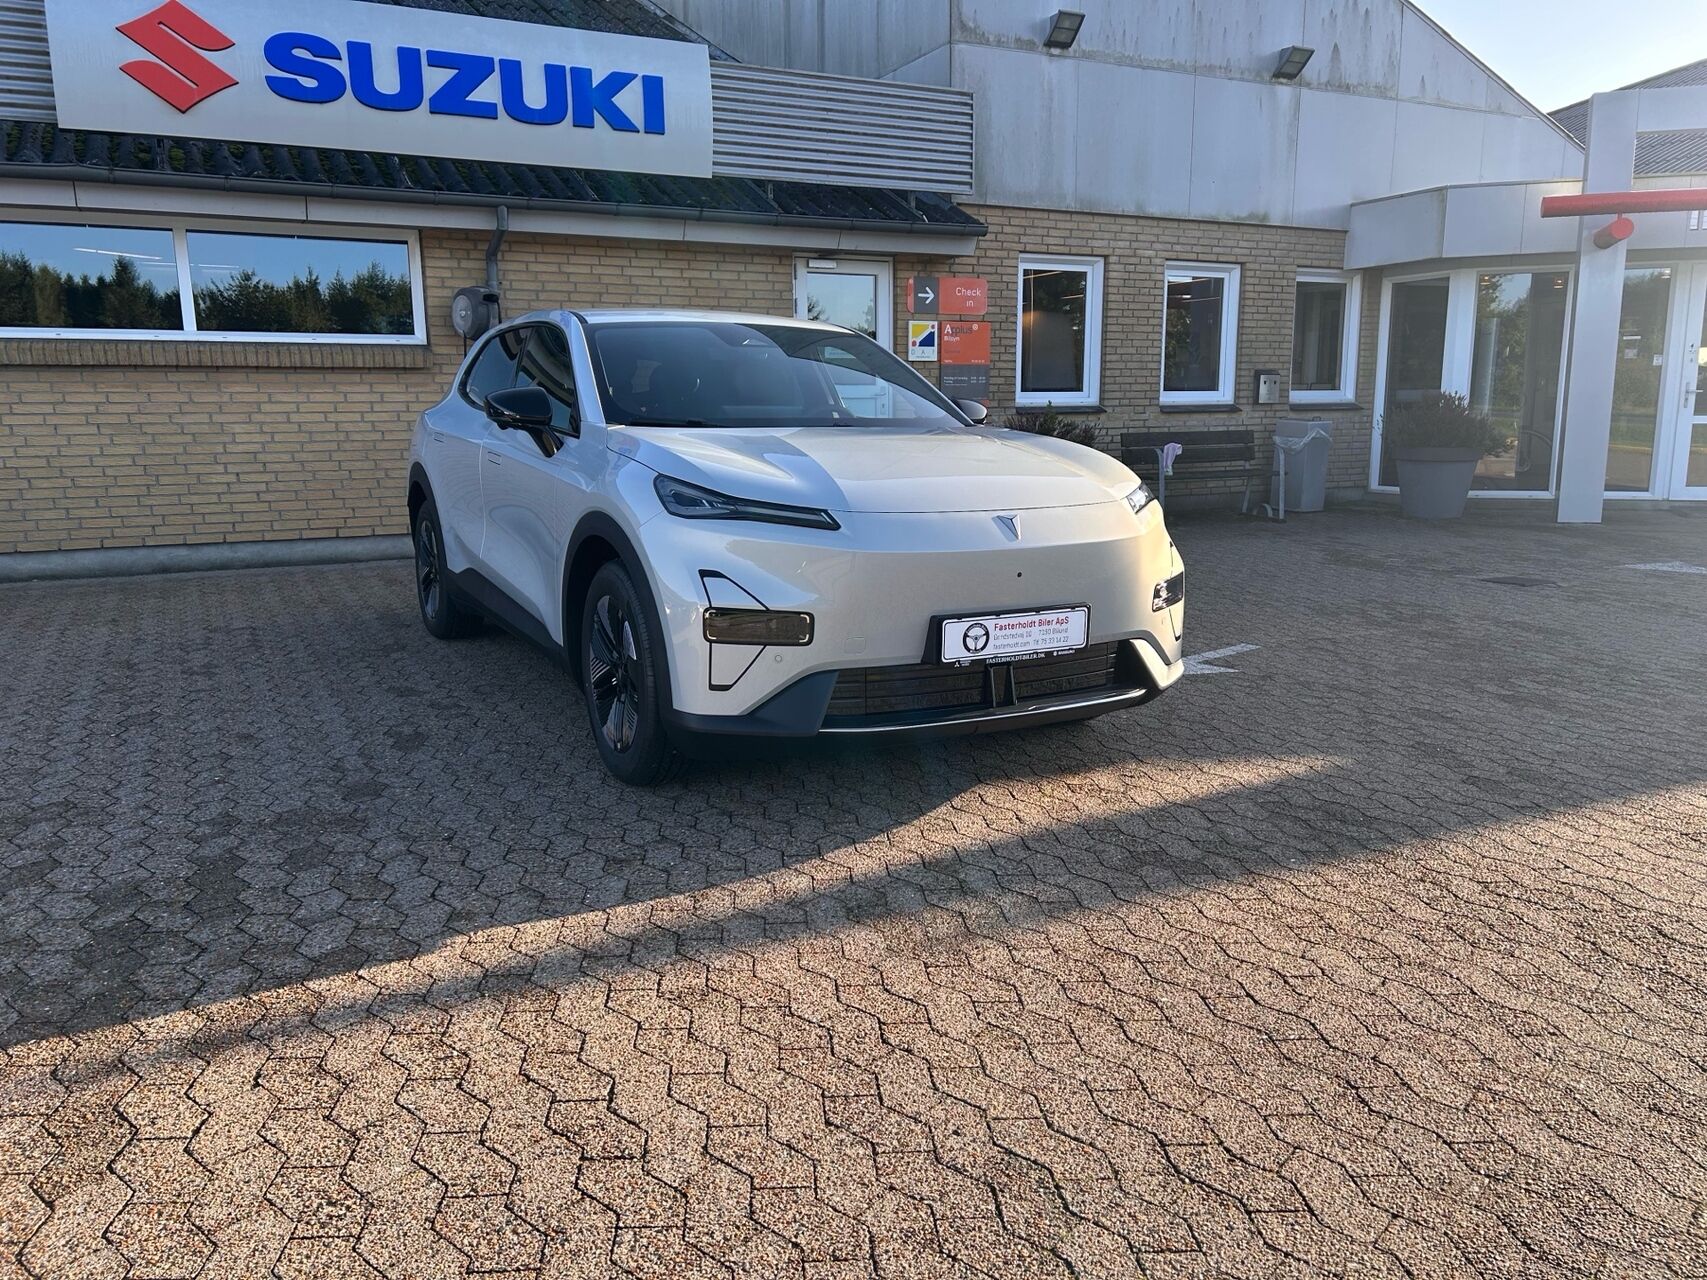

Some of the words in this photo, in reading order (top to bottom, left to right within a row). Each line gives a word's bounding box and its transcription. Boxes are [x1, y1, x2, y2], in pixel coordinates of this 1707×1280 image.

[263, 31, 666, 136] SUZUKI
[955, 287, 982, 297] Check
[994, 620, 1036, 632] Fasterholdt
[1038, 618, 1054, 628] Biler
[1055, 616, 1070, 627] ApS
